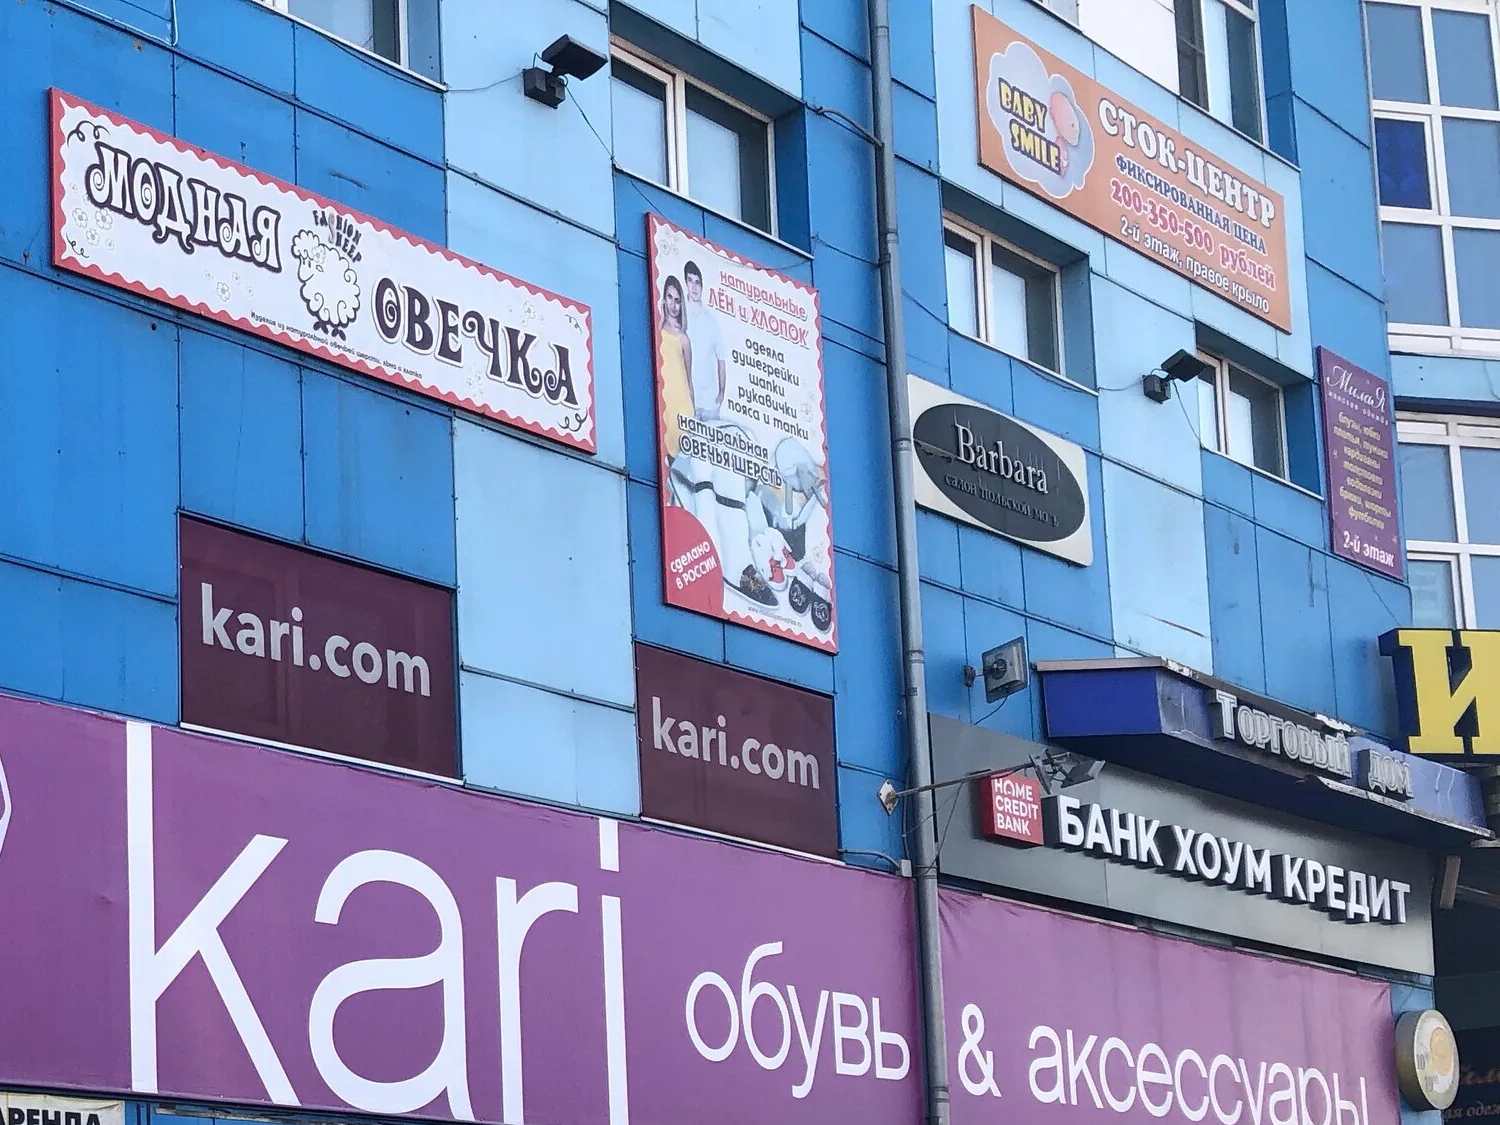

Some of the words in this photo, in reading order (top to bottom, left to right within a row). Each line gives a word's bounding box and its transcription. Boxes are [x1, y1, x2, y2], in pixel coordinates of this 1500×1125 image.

[999, 78, 1047, 133] BABY
[1009, 119, 1061, 175] SMILE
[1098, 99, 1275, 229] СТОК-ЦЕНТР
[1115, 154, 1231, 233] ФИКСИРОВАННАЯ
[1234, 224, 1268, 255] ЦЕНА
[1110, 180, 1214, 255] 200-350-500
[1219, 243, 1276, 290] рублей
[85, 142, 282, 272] МОДНАЯ
[372, 276, 581, 409] ОВЕЧКА
[1120, 216, 1140, 243] 2-й
[1185, 255, 1229, 292] правое
[1231, 280, 1270, 313] крыло
[709, 287, 734, 315] ЛЁН
[739, 308, 747, 319] и
[751, 305, 809, 346] ХЛОПОК
[720, 271, 807, 319] натуральные
[732, 350, 799, 386] душегрейки
[745, 338, 784, 363] одеяла
[738, 386, 797, 419] рукавички
[749, 374, 785, 397] шапки
[680, 415, 768, 459] натуральная
[728, 399, 759, 420] пояса
[763, 411, 770, 424] и
[774, 416, 809, 440] тапки
[680, 435, 731, 467] ОВЕЧЬЯ
[733, 455, 783, 488] ШЕРСТЬ
[956, 423, 1048, 494] Barbara
[670, 541, 710, 573] сделано
[676, 577, 683, 589] в
[683, 558, 717, 585] РОССИИ
[1343, 531, 1360, 556] 2-й
[1363, 541, 1395, 567] этаж
[202, 583, 431, 698] kari.com
[652, 697, 820, 790] kari.com
[994, 779, 1034, 800] HOME
[995, 797, 1039, 821] CREDIT
[997, 814, 1031, 836] BANK
[1058, 795, 1163, 867] БАНК
[1173, 826, 1271, 893] ХОУМ
[1284, 855, 1410, 924] КРЕДИТ
[686, 941, 909, 1099] обувь
[958, 1003, 1001, 1098] &
